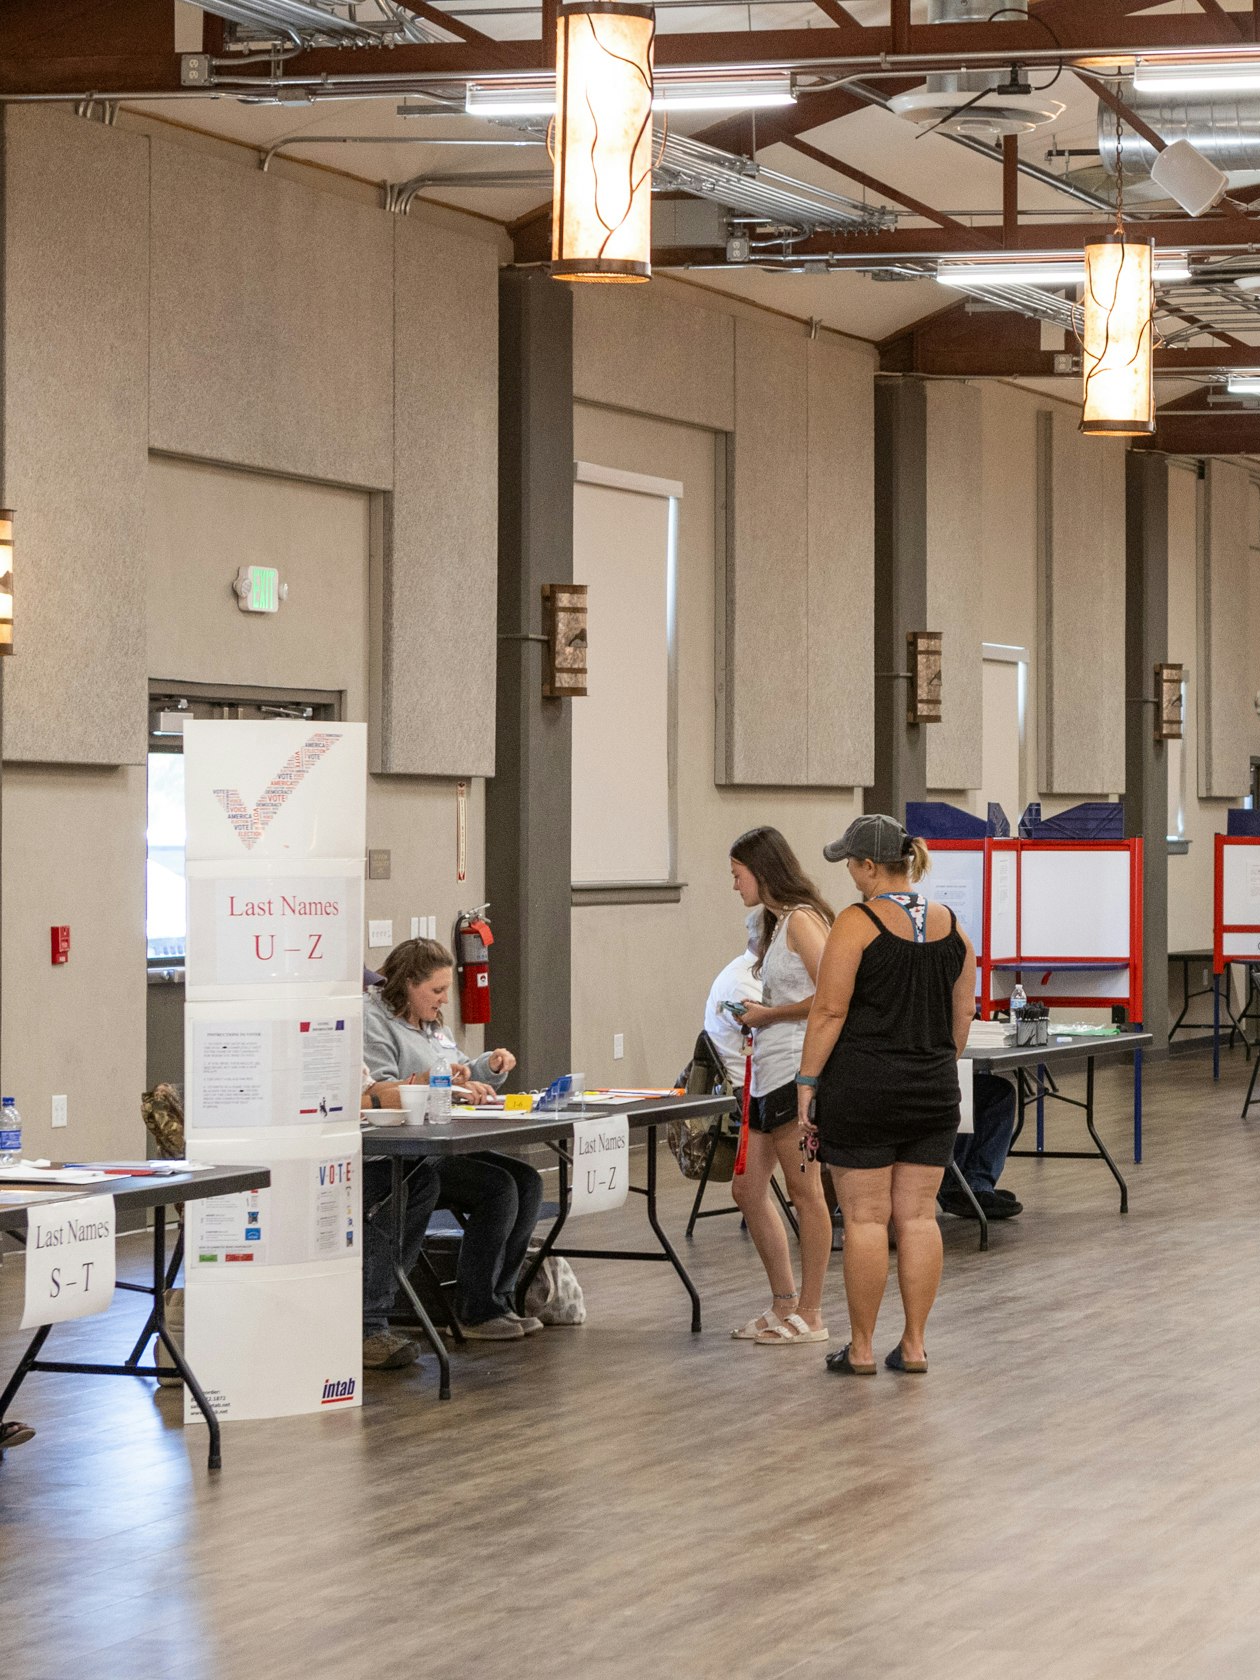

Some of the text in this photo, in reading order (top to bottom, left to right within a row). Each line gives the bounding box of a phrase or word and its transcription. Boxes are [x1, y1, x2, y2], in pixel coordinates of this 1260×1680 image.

[253, 569, 275, 609] EXIT
[229, 895, 339, 917] Last Names
[253, 934, 277, 961] U
[307, 934, 324, 960] Z
[579, 1132, 626, 1155] Last Names
[319, 1162, 352, 1185] VOTE
[587, 1169, 597, 1194] U
[608, 1166, 617, 1190] Z
[35, 1219, 109, 1250] Last Names
[49, 1267, 62, 1299] S
[82, 1262, 94, 1292] T
[321, 1377, 356, 1399] intab
